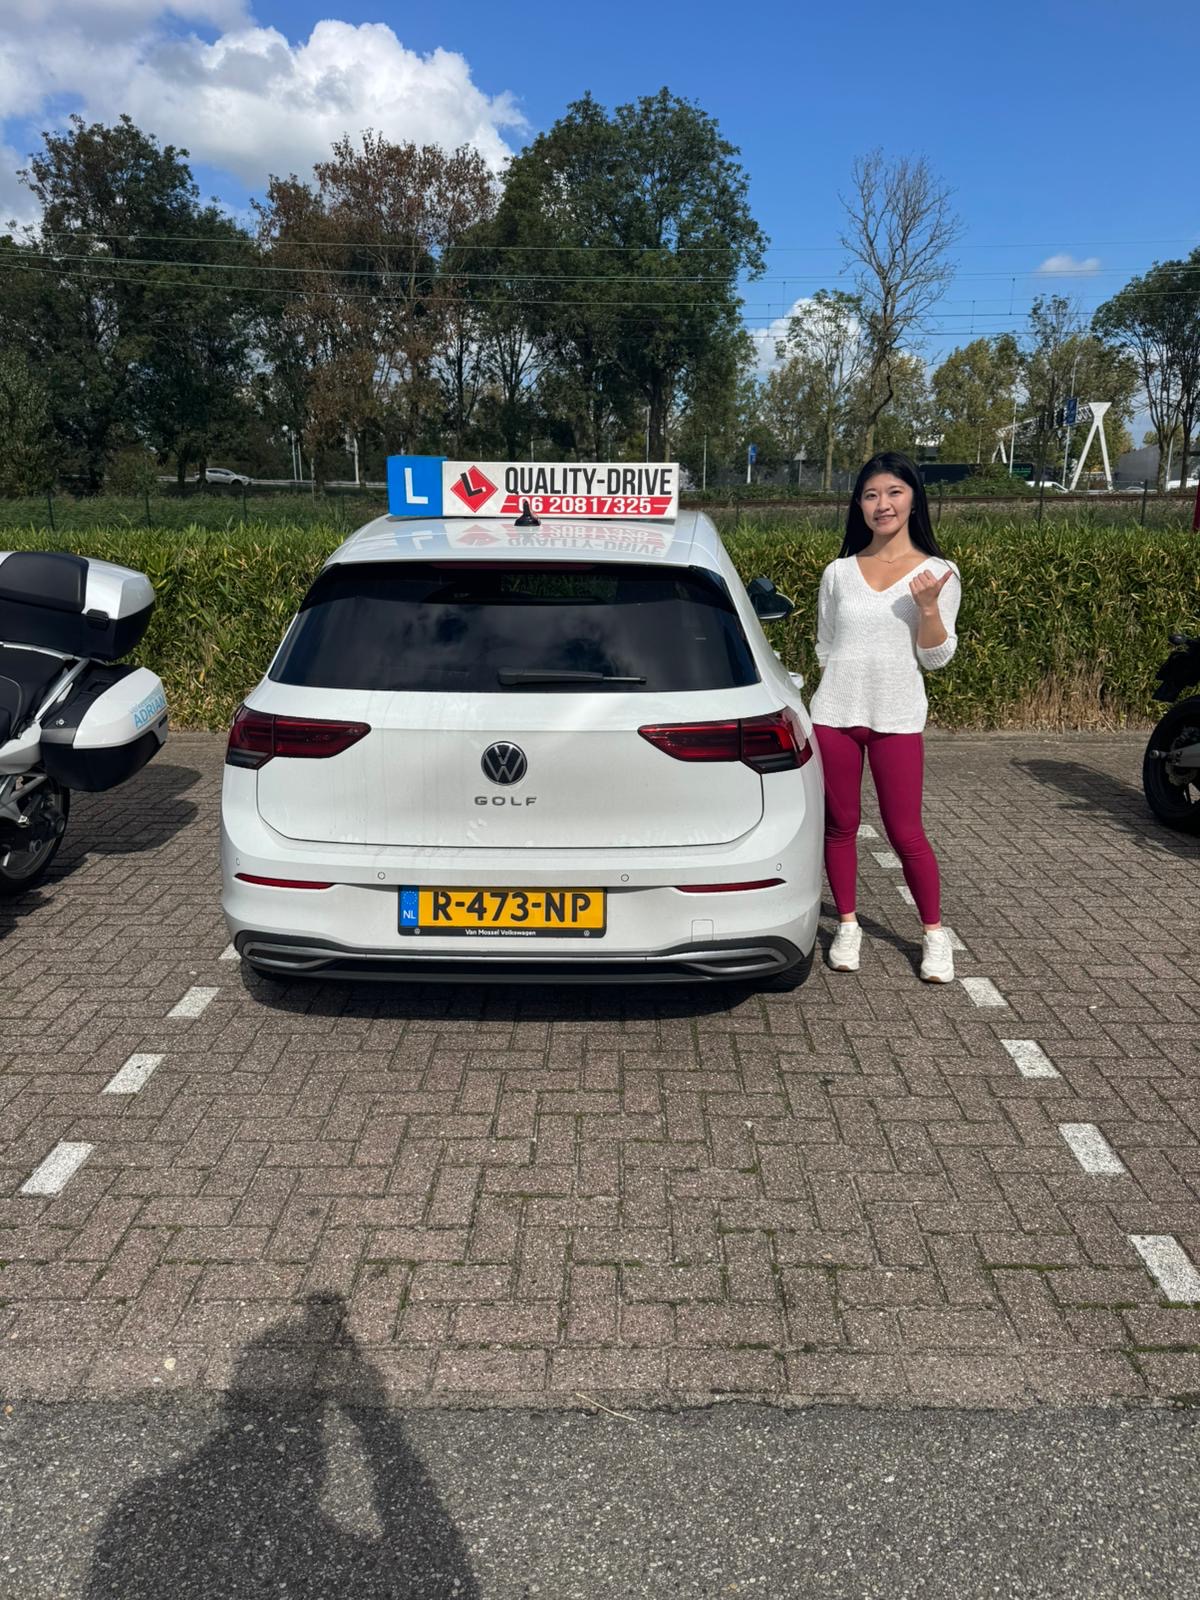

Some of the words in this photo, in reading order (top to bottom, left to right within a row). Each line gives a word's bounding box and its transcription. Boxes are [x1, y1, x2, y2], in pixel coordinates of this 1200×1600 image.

[404, 467, 429, 504] L
[505, 467, 672, 495] QUALITY-DRIVE
[549, 497, 651, 513] 20817325
[474, 796, 537, 806] GOLF
[403, 909, 416, 919] NL
[432, 891, 591, 922] R-473-NP
[501, 929, 536, 937] Volkswagen
